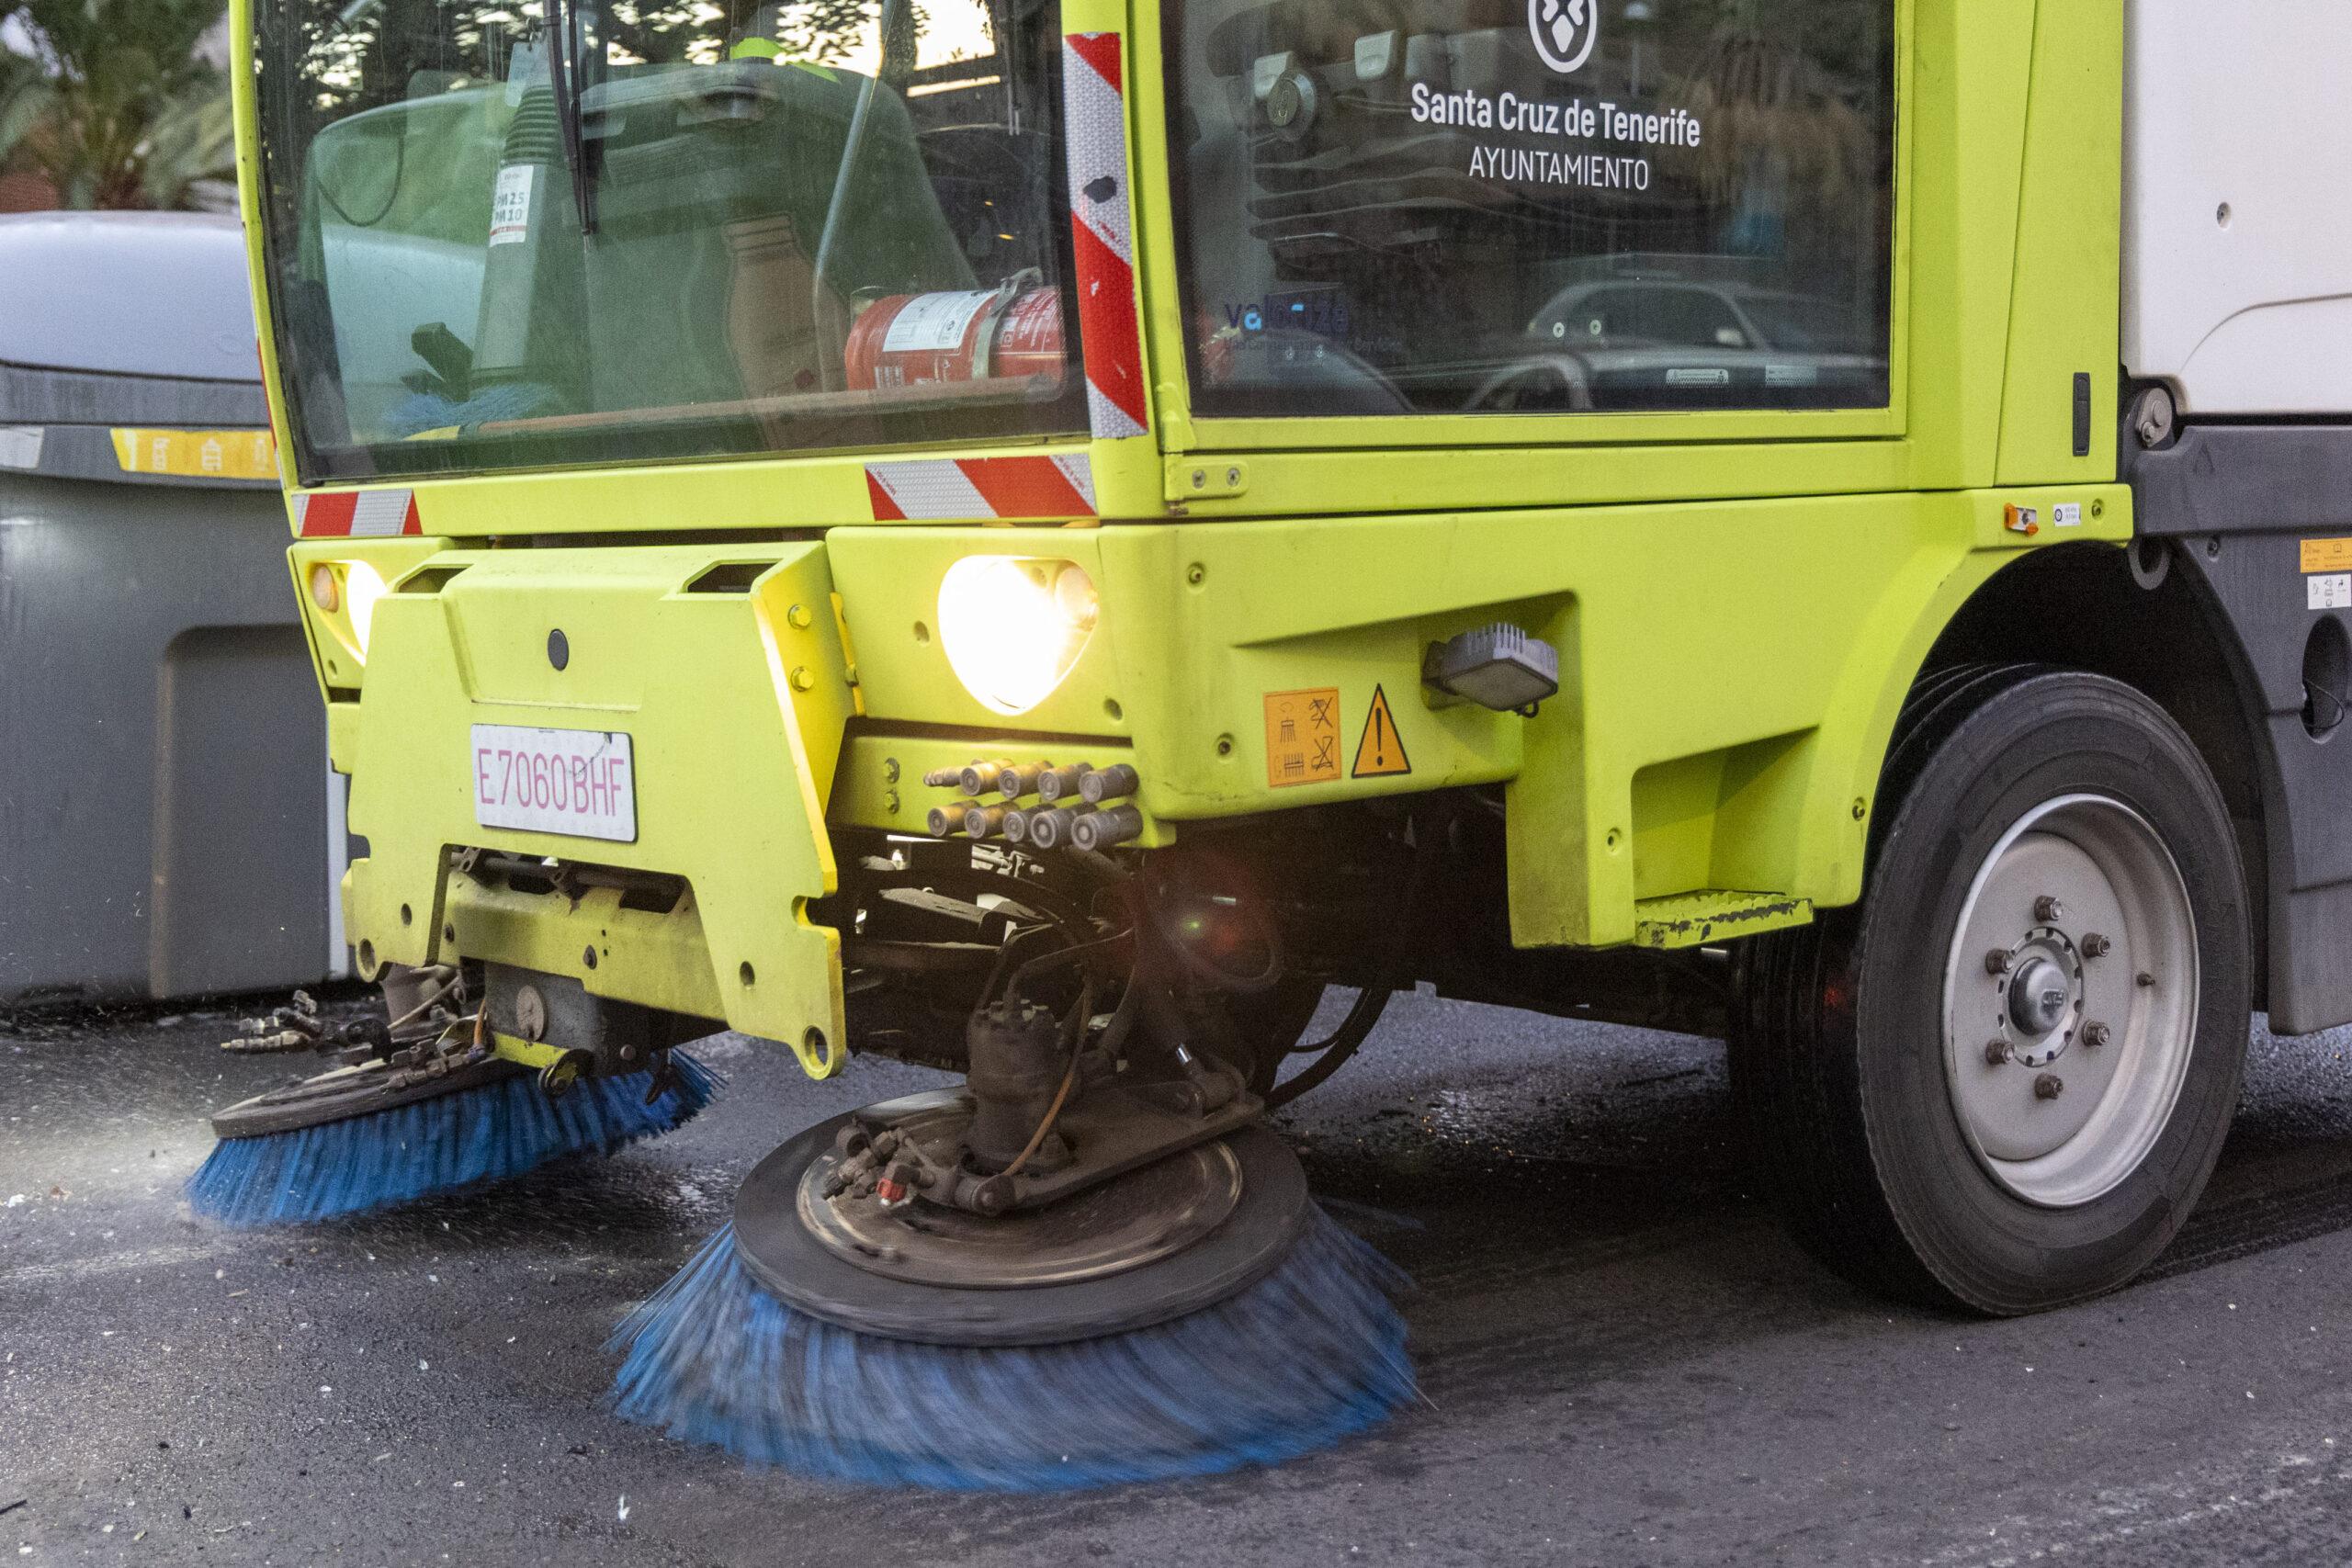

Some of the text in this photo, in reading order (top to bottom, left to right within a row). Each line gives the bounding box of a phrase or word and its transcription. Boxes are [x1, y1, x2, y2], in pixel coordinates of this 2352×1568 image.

[1411, 83, 1701, 147] Santa Cruz de Tenerife
[1469, 146, 1648, 190] AYUNTAMIENTO
[507, 209, 523, 221] 10
[478, 748, 625, 817] E7060BHF
